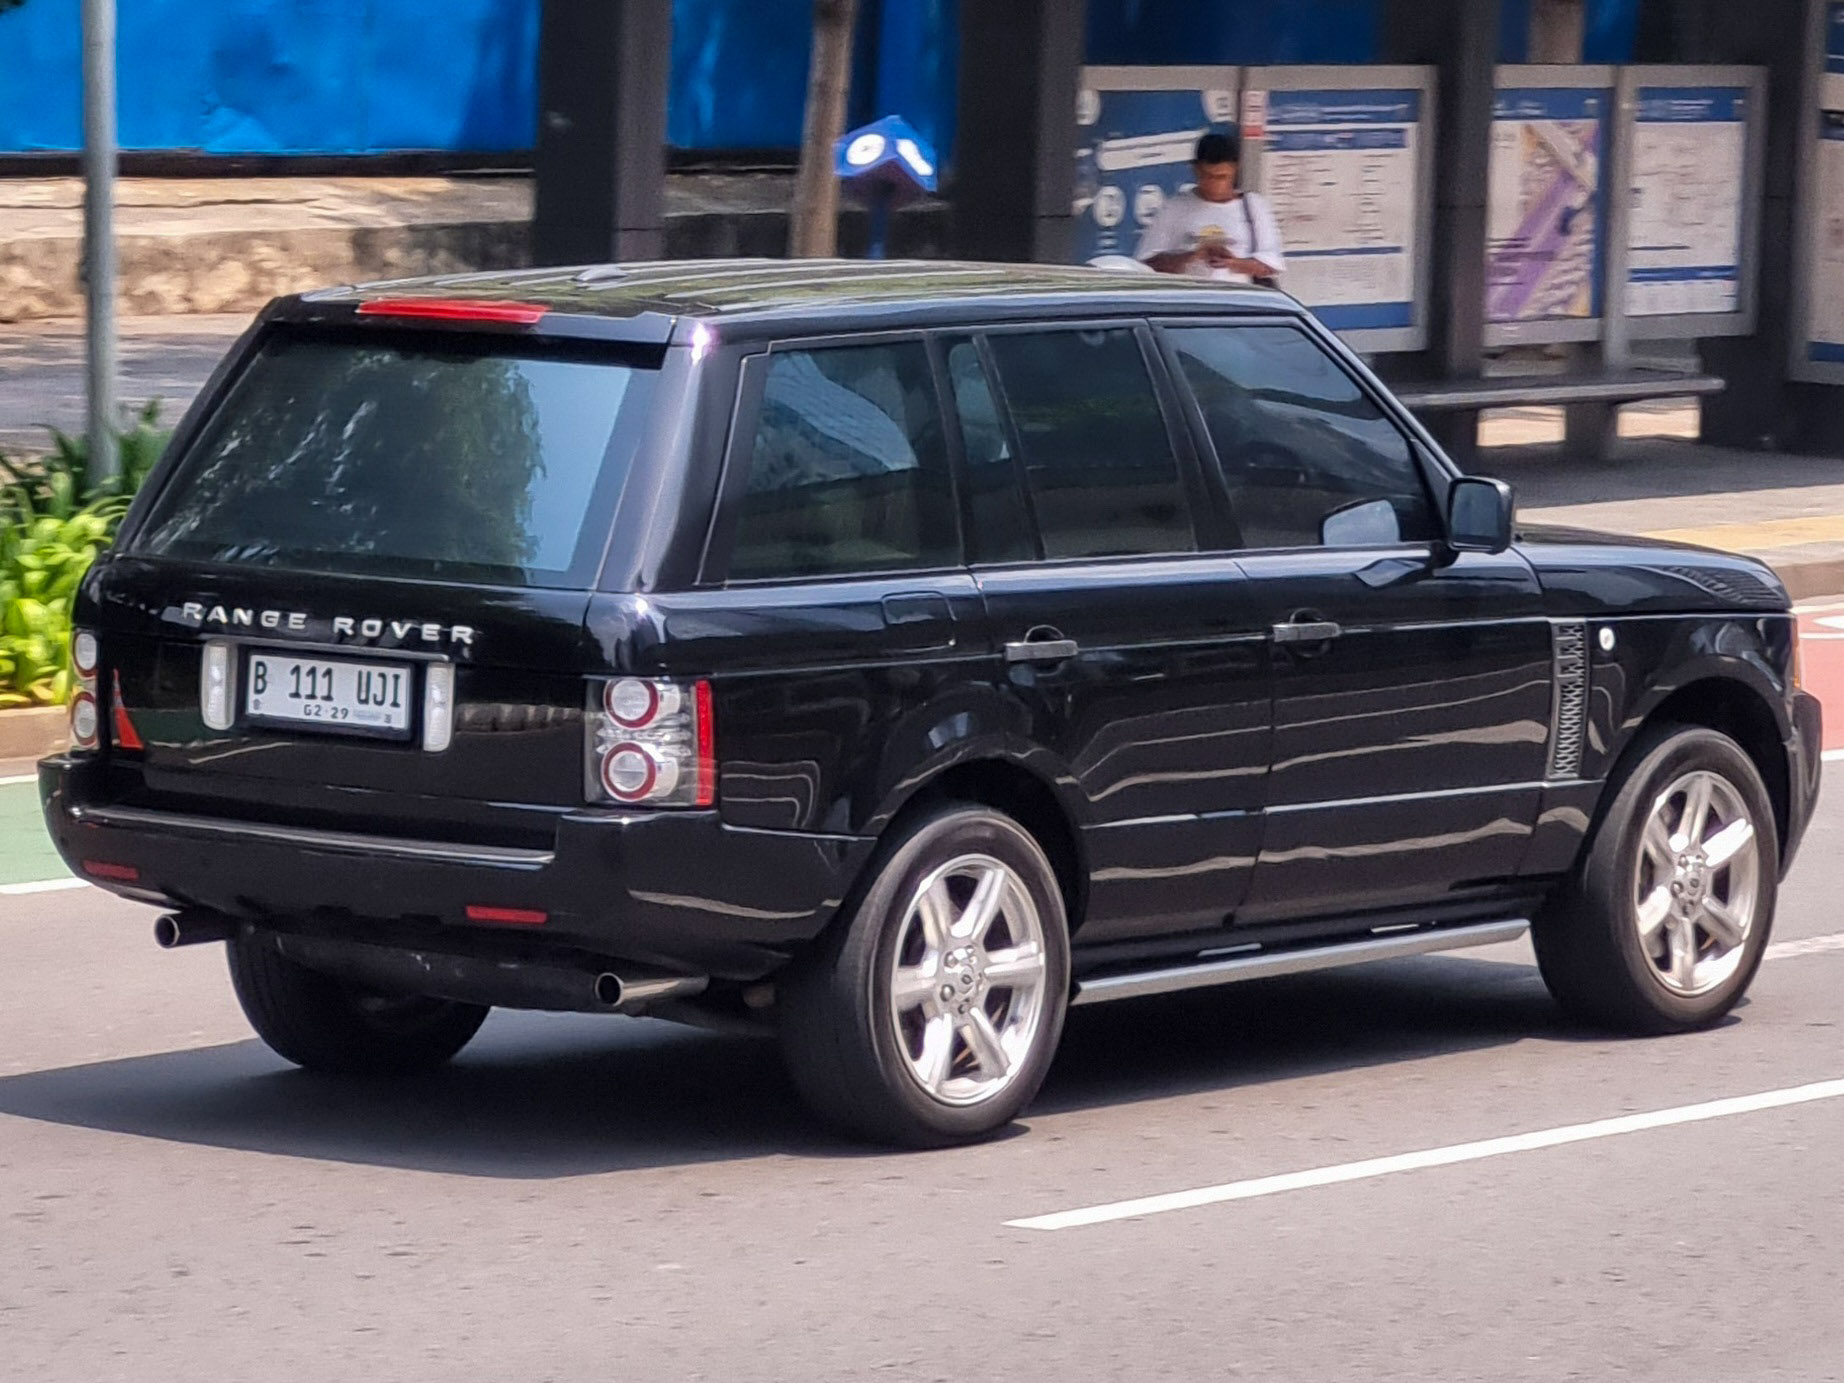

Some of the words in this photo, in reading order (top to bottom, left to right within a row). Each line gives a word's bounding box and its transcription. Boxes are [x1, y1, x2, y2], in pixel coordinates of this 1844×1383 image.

[182, 602, 307, 630] RANGE
[333, 617, 475, 645] ROVER
[253, 661, 267, 695] B
[288, 664, 334, 702] 111
[357, 669, 401, 708] UJI
